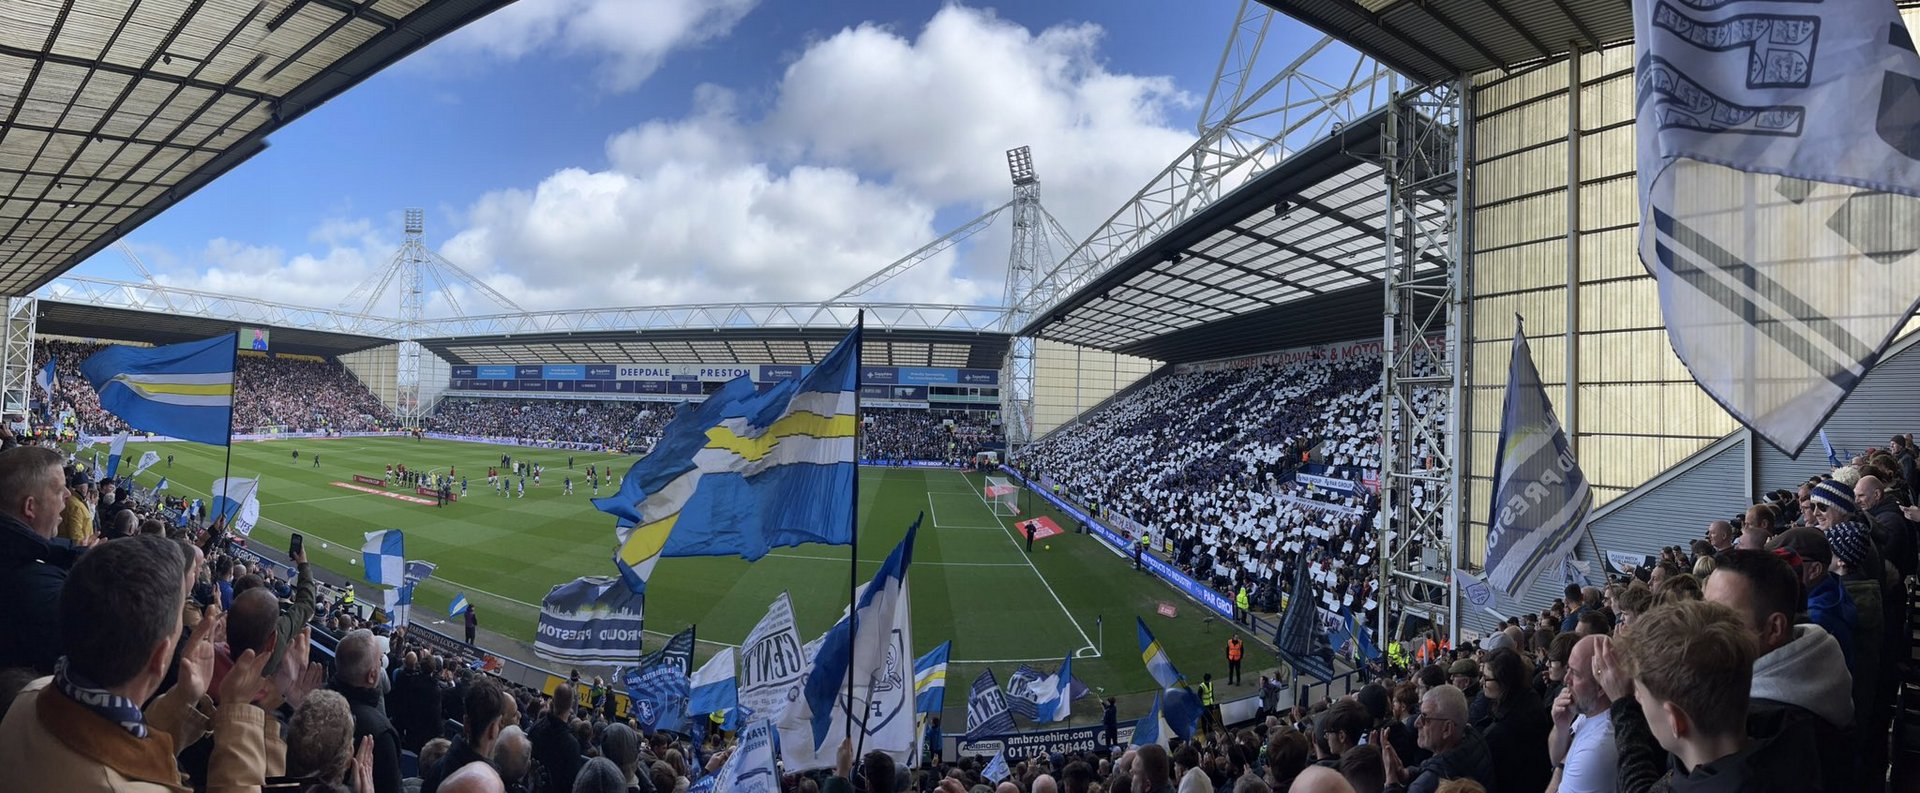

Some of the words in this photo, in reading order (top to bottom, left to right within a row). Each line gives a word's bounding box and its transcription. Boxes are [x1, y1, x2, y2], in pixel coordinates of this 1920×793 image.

[1330, 348, 1338, 361] &
[620, 368, 670, 377] DEEPDALE
[700, 368, 751, 378] PRESTON
[1204, 590, 1216, 606] PAR
[1008, 730, 1093, 745] ambrosehire.com
